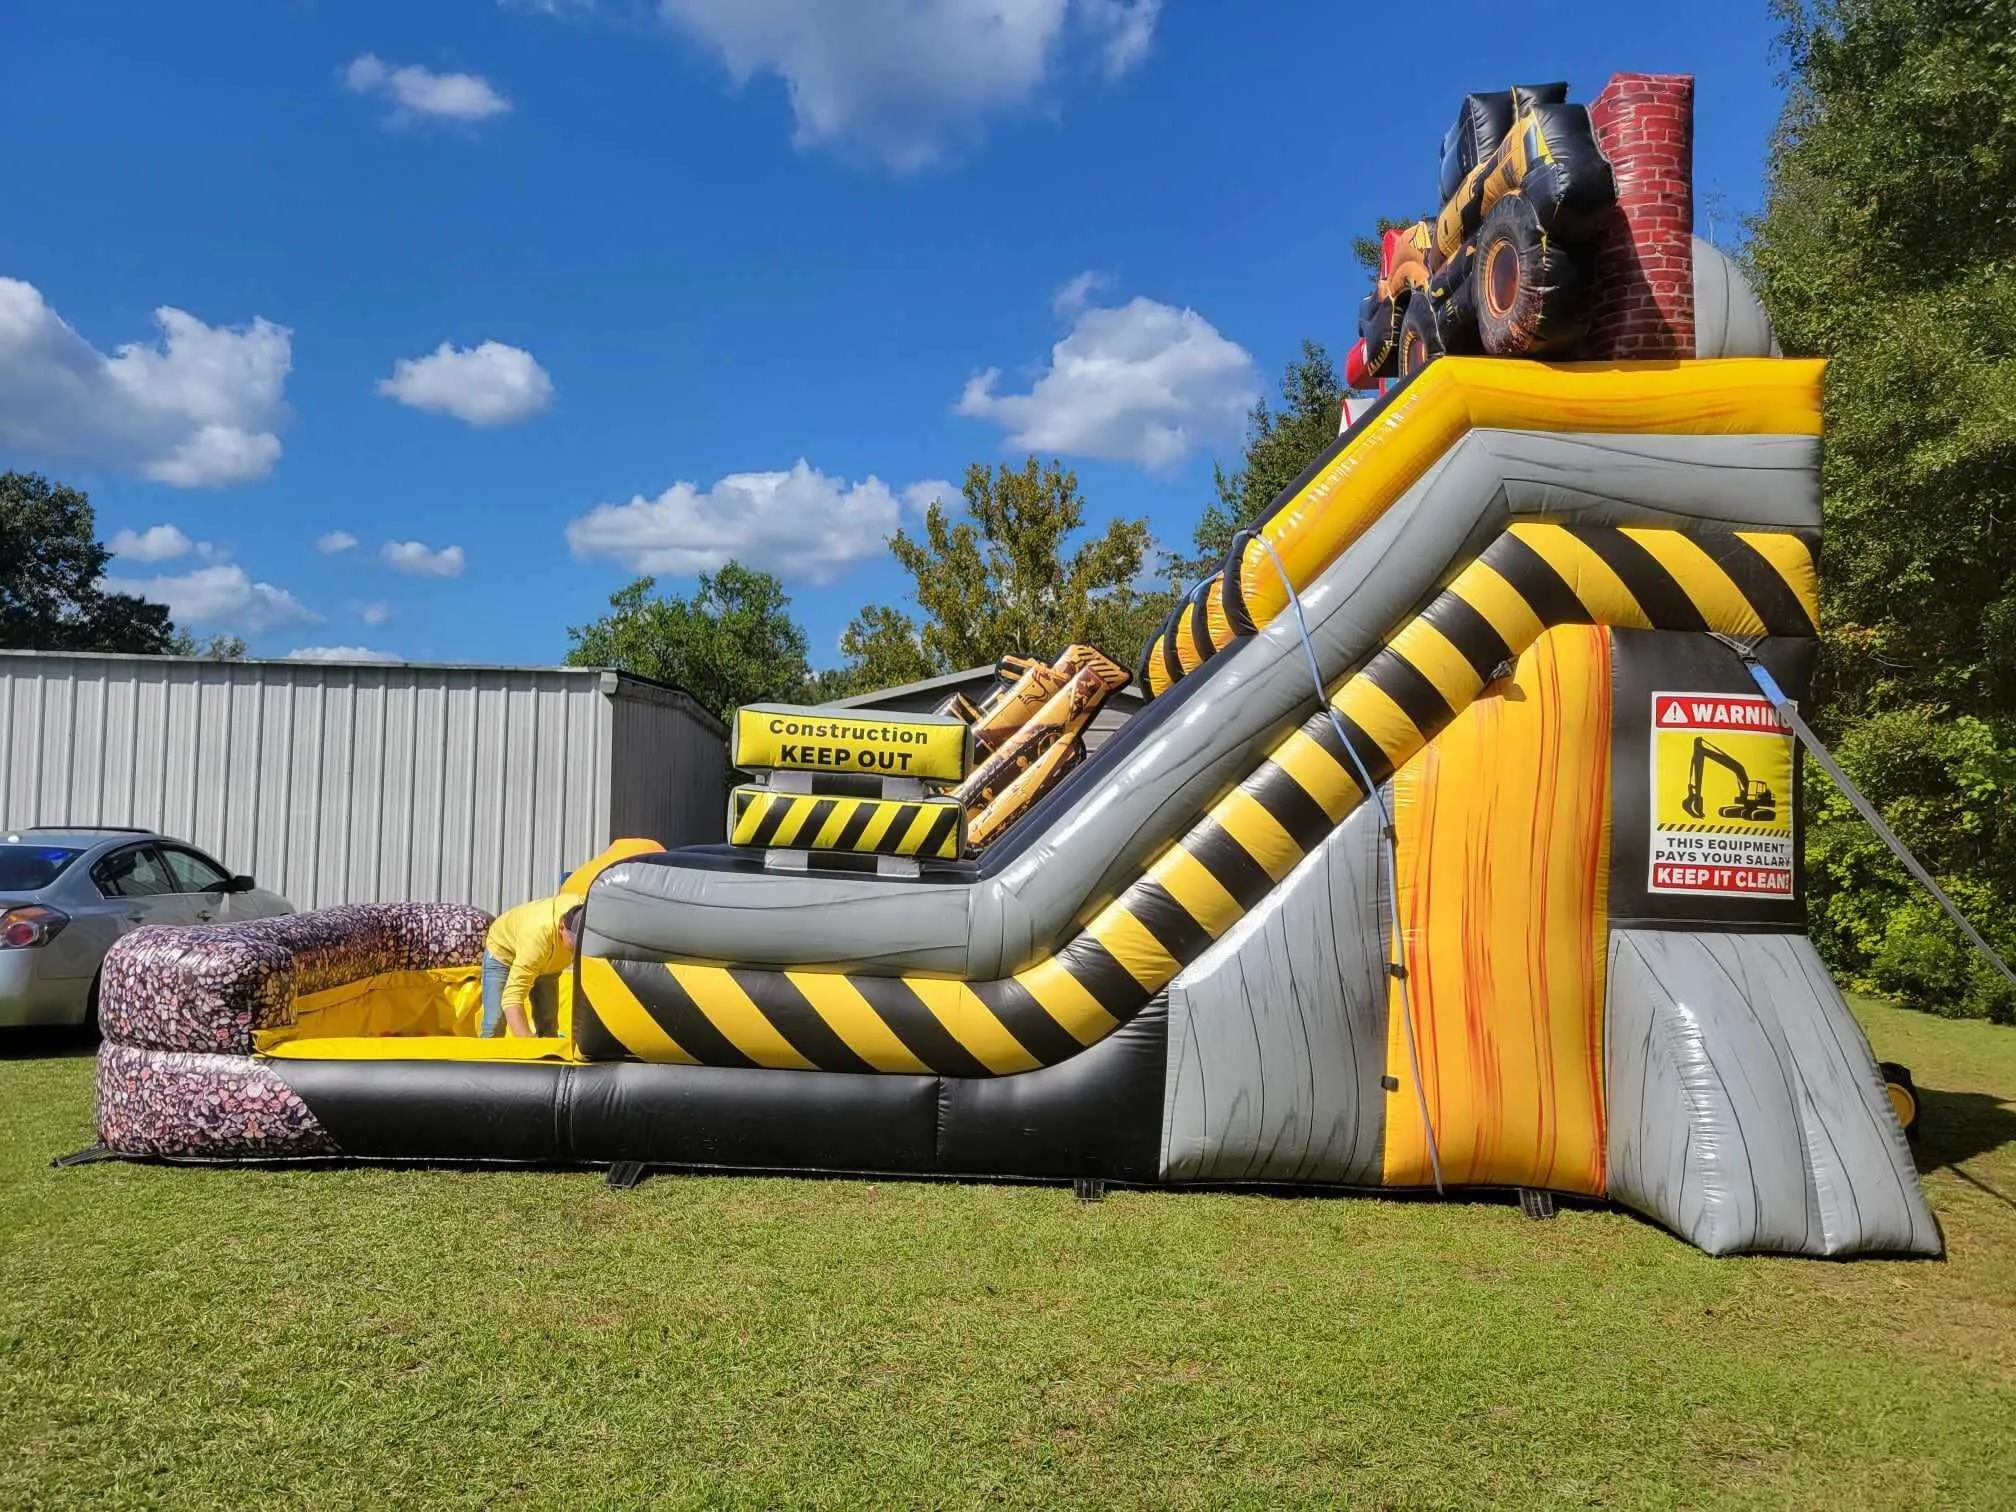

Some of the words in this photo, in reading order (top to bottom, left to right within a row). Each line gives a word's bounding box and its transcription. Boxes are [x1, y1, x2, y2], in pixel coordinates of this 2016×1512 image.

[769, 719, 928, 745] Construction
[781, 744, 850, 766] KEEP
[857, 750, 913, 771] OUT
[1666, 837, 1704, 849] THIS
[1708, 840, 1784, 853] EQUIPMENT
[1655, 850, 1697, 862] PAYS
[1702, 852, 1742, 865] YOUR
[1746, 855, 1791, 867] SALARY
[1657, 867, 1710, 884] KEEP
[1713, 870, 1732, 886] IT
[1735, 871, 1790, 890] CLEAN!
